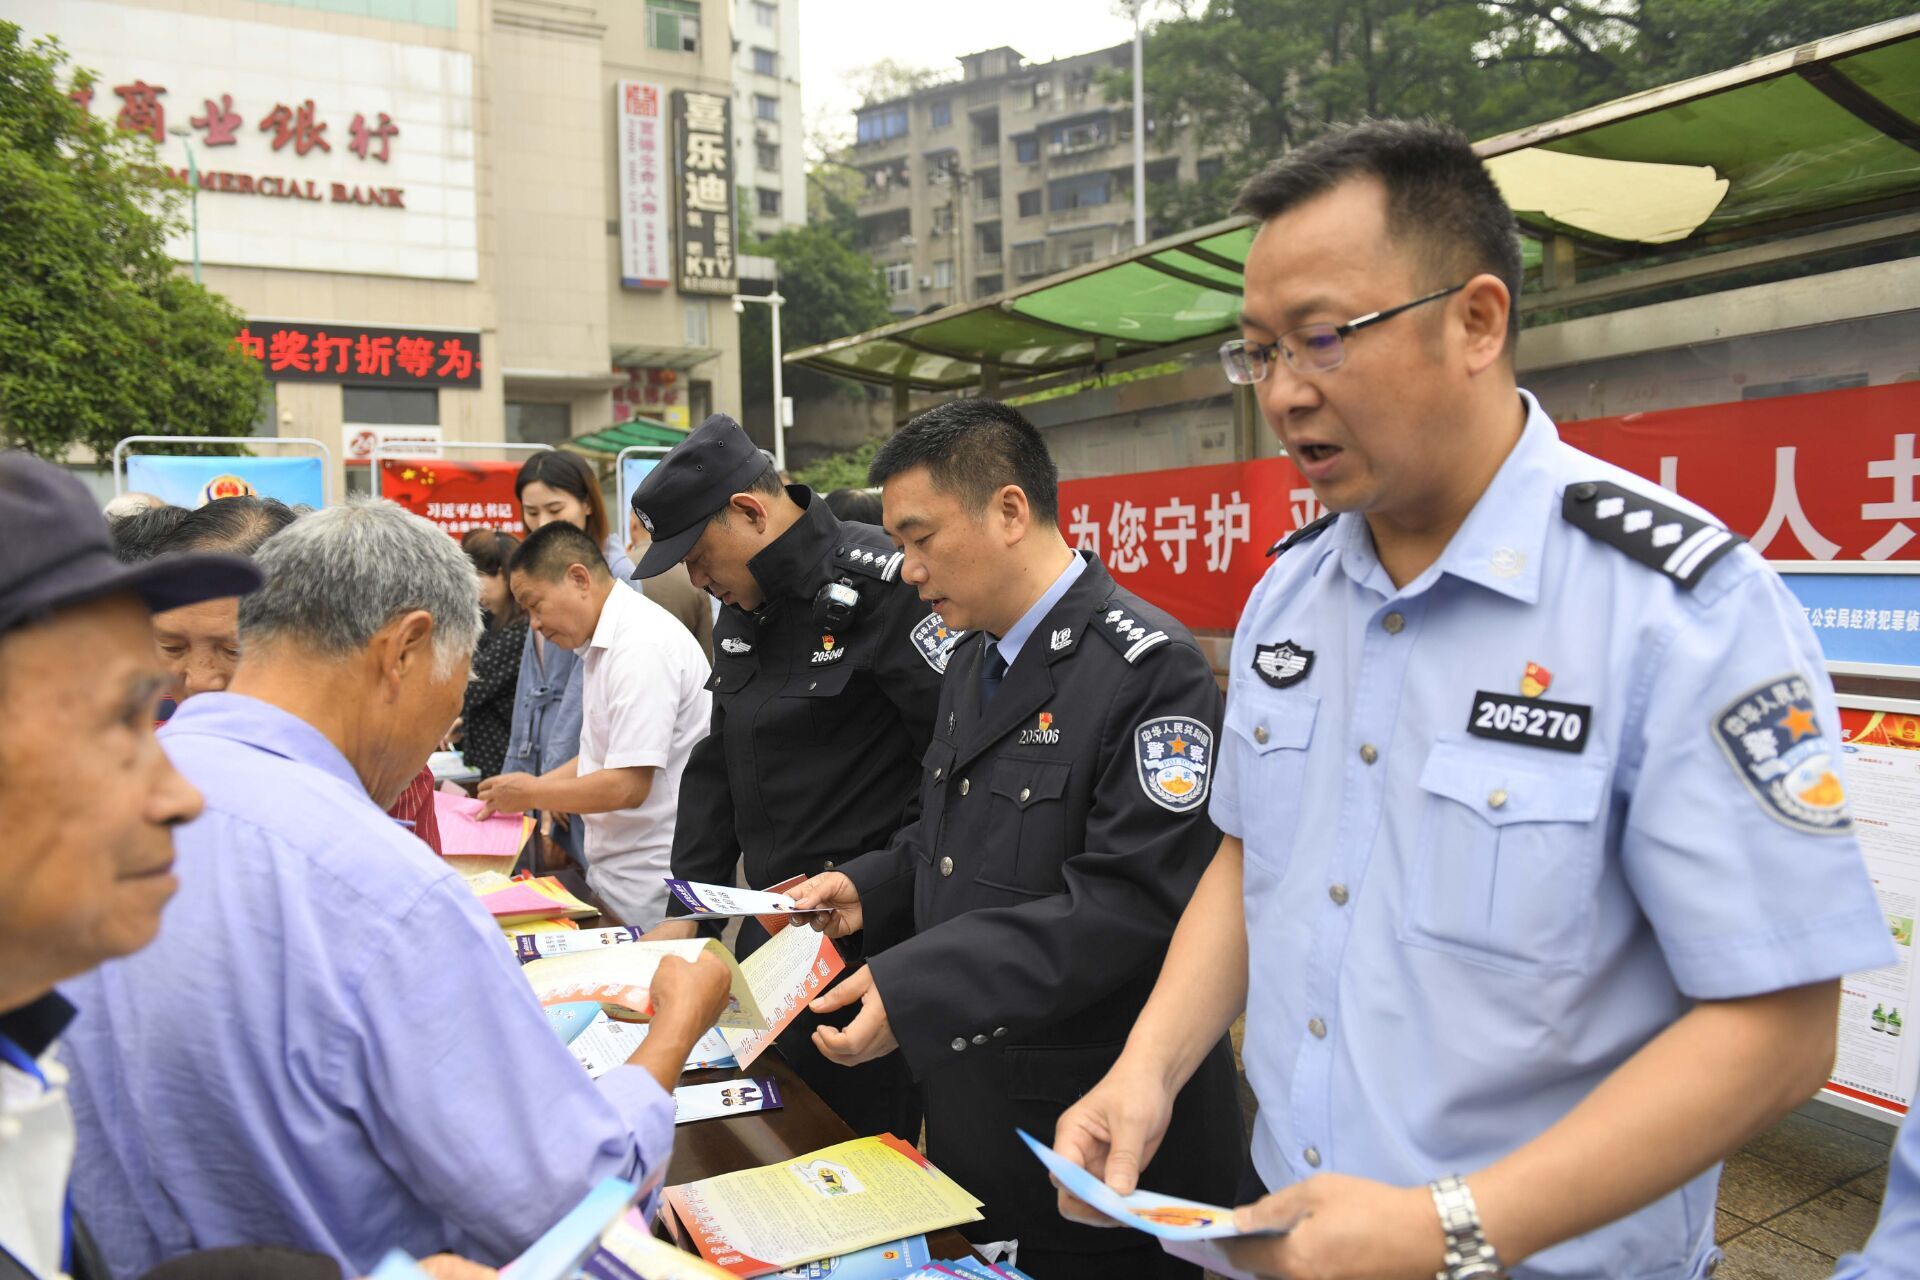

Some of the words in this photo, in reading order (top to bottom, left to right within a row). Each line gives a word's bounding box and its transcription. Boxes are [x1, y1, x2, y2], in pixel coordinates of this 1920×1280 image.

[683, 92, 727, 213] 喜乐迪
[331, 183, 405, 208] BANK
[685, 256, 732, 278] KTV
[427, 503, 513, 519] 习近平总书记
[1068, 491, 1251, 574] 为您守护
[1475, 701, 1582, 742] 205270
[1019, 729, 1060, 744] 205006
[1141, 722, 1209, 747] 中华人民共和国
